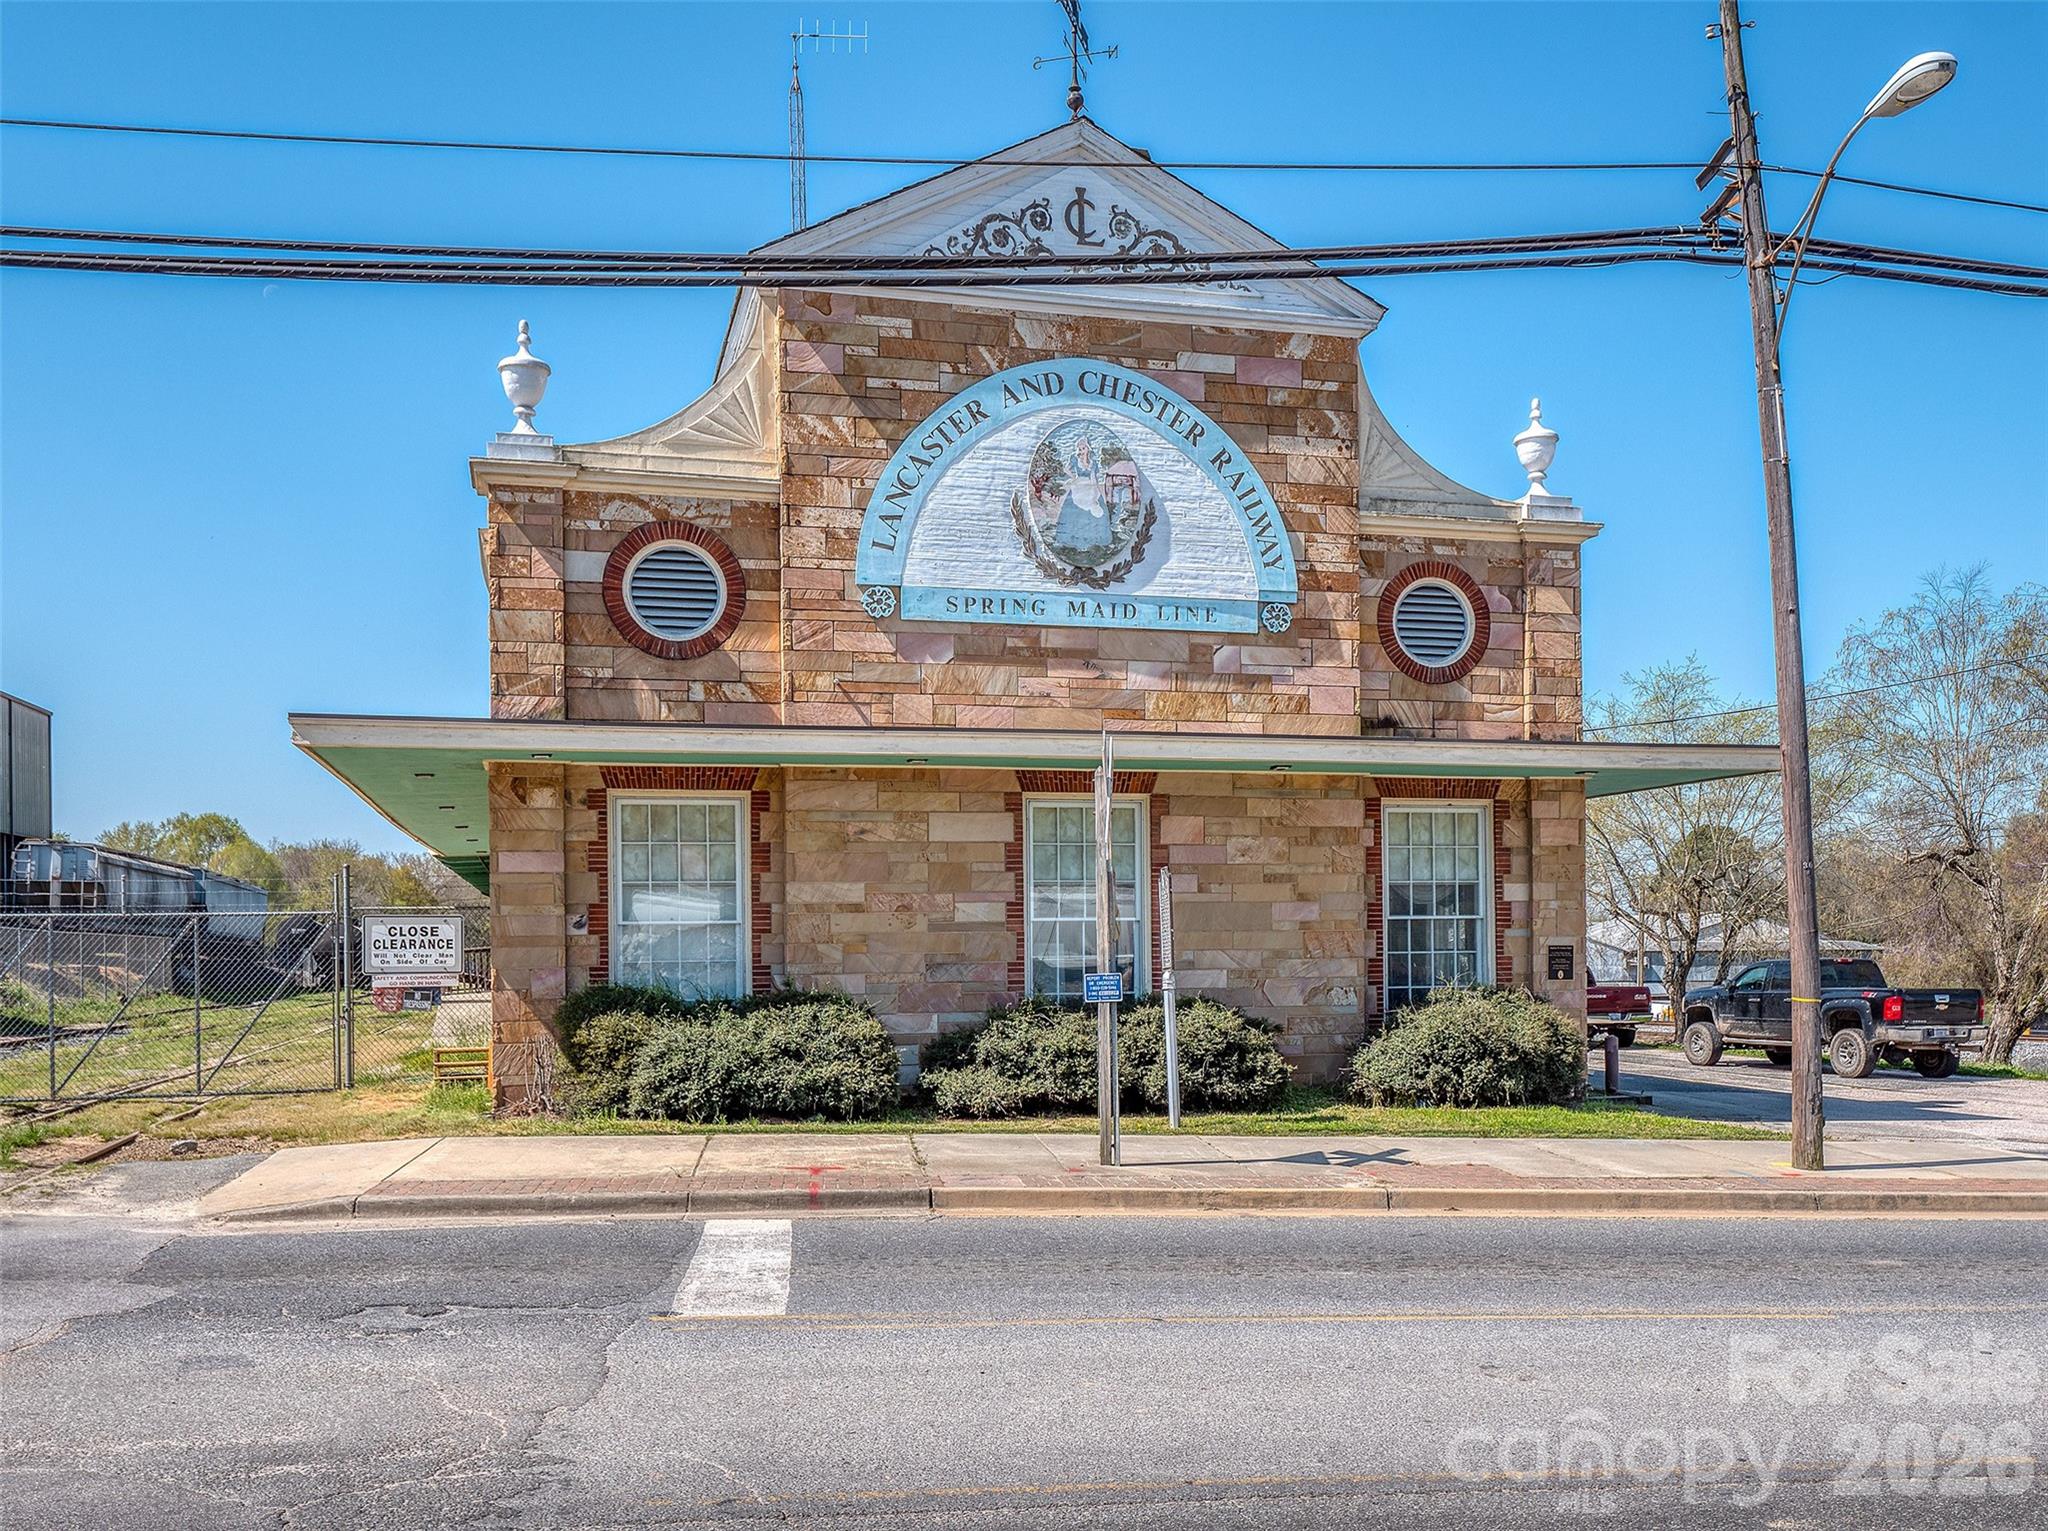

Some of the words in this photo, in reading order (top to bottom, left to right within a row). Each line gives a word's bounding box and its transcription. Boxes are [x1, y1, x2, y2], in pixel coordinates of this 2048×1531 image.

[872, 399, 991, 555] LANCASTER
[1002, 371, 1064, 409] AND
[1078, 370, 1206, 448] CHESTER
[1208, 446, 1285, 571] RAILWAY
[946, 595, 1047, 617] SPRING
[1067, 600, 1137, 620] MAID
[1157, 604, 1218, 623] LINE
[388, 926, 439, 937] CLOSE
[373, 939, 454, 950] CLEARANCE
